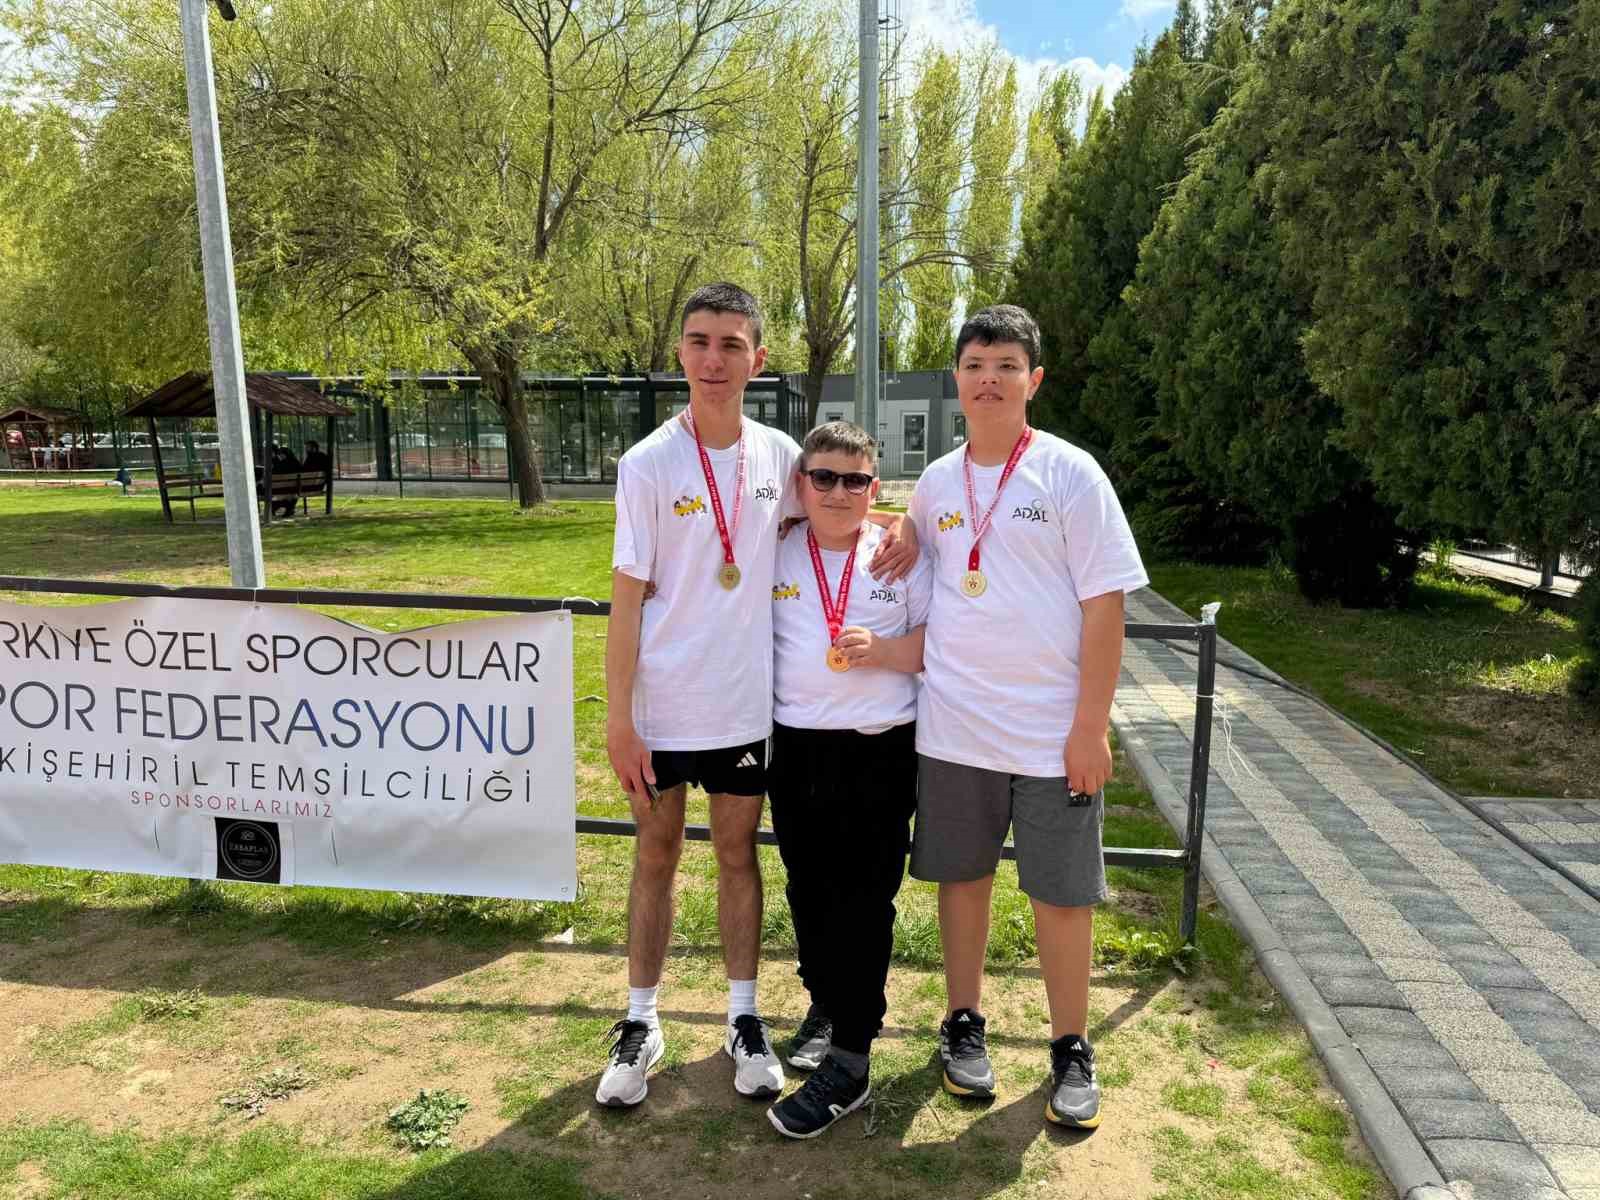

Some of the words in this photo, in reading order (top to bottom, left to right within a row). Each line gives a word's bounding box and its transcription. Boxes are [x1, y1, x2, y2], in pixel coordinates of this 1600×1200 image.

[125, 618, 232, 672] ÖZEL
[246, 633, 541, 683] SPORCULAR
[0, 681, 96, 732] OR
[115, 687, 535, 756] FEDERASYONU
[130, 790, 334, 818] SPONSORLARIMIZ
[225, 761, 531, 803] TEMSİLCİLİĞİ
